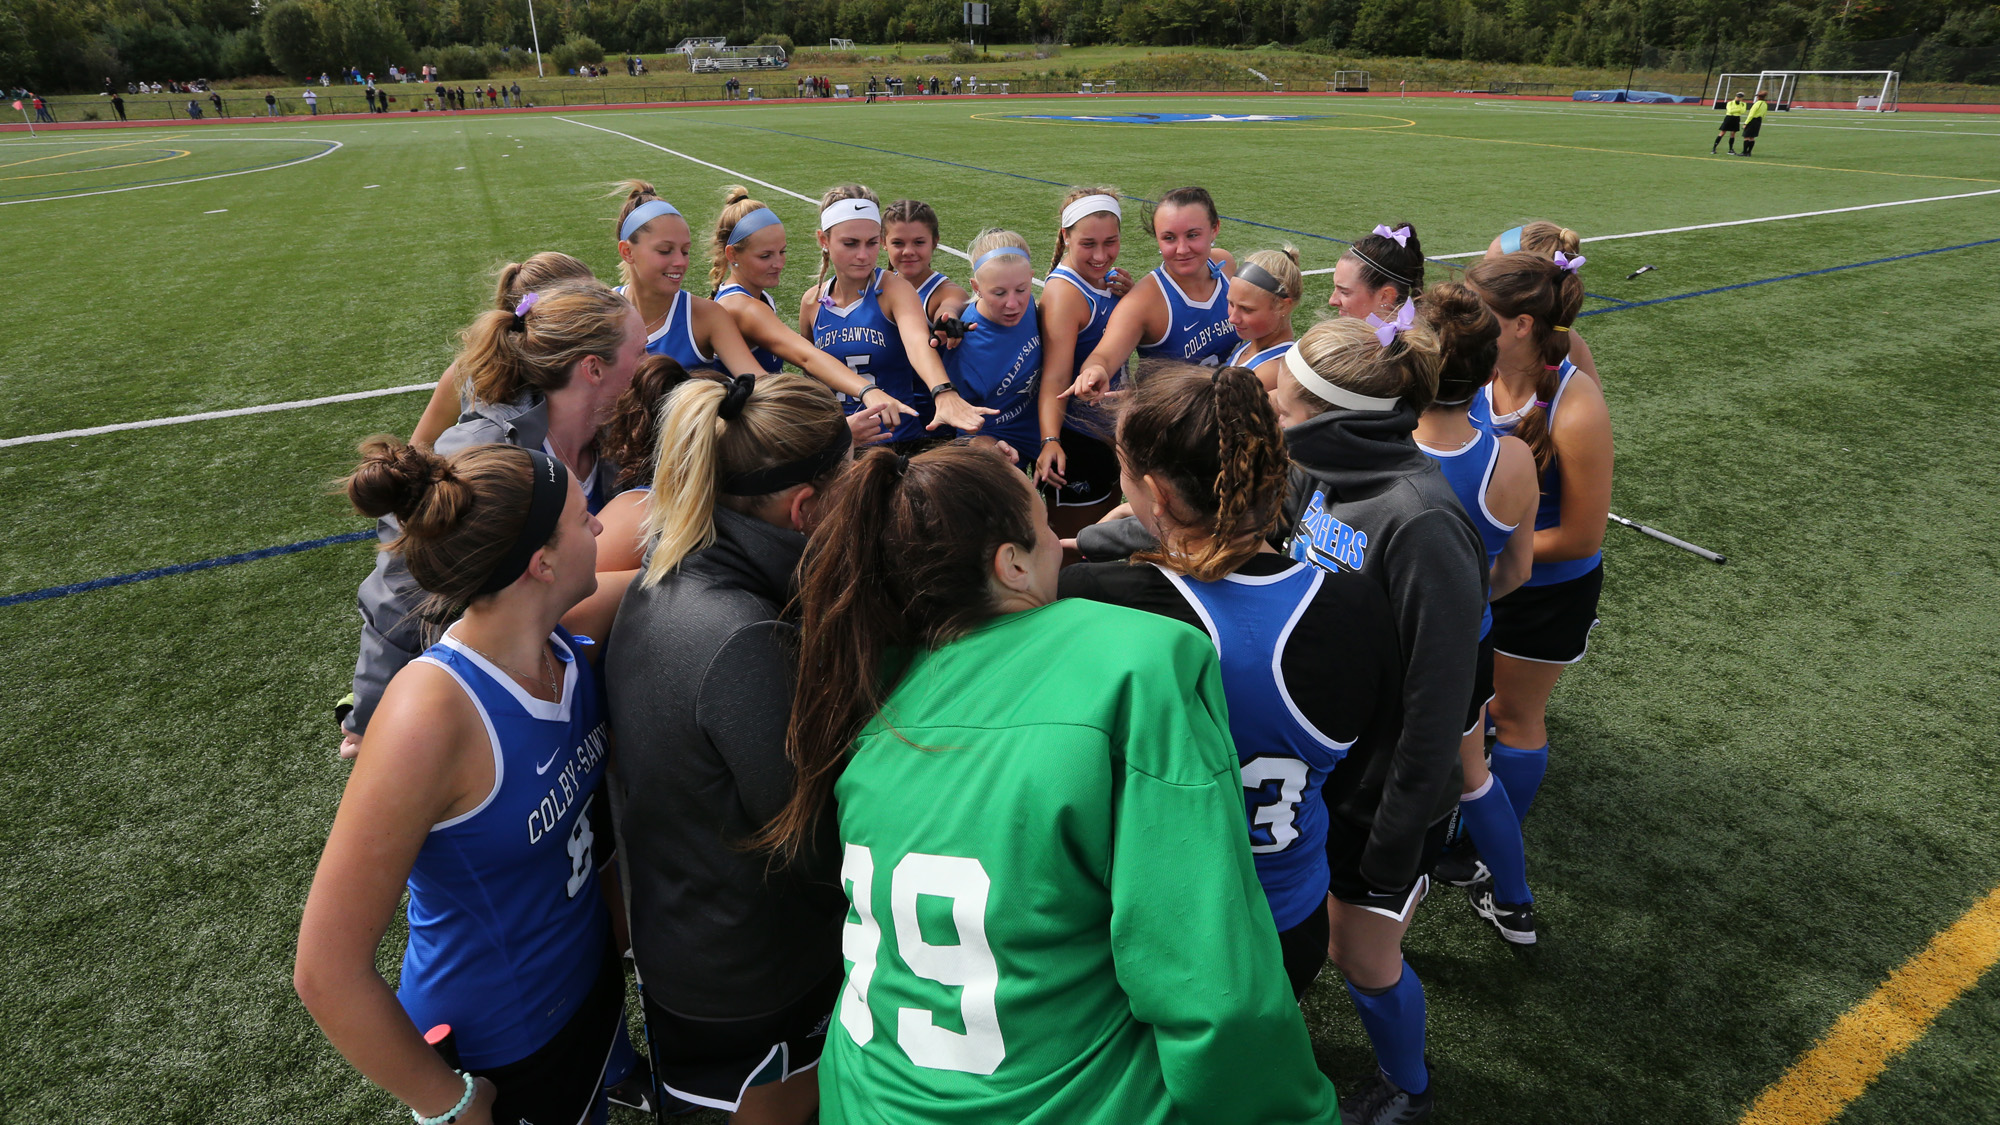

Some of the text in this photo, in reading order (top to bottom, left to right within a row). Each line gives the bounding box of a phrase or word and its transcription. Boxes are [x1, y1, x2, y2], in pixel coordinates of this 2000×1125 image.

[996, 335, 1041, 396] COLBY-SAW
[1184, 318, 1235, 359] COLBY-SAW
[1240, 755, 1310, 854] 3
[566, 792, 595, 899] 8
